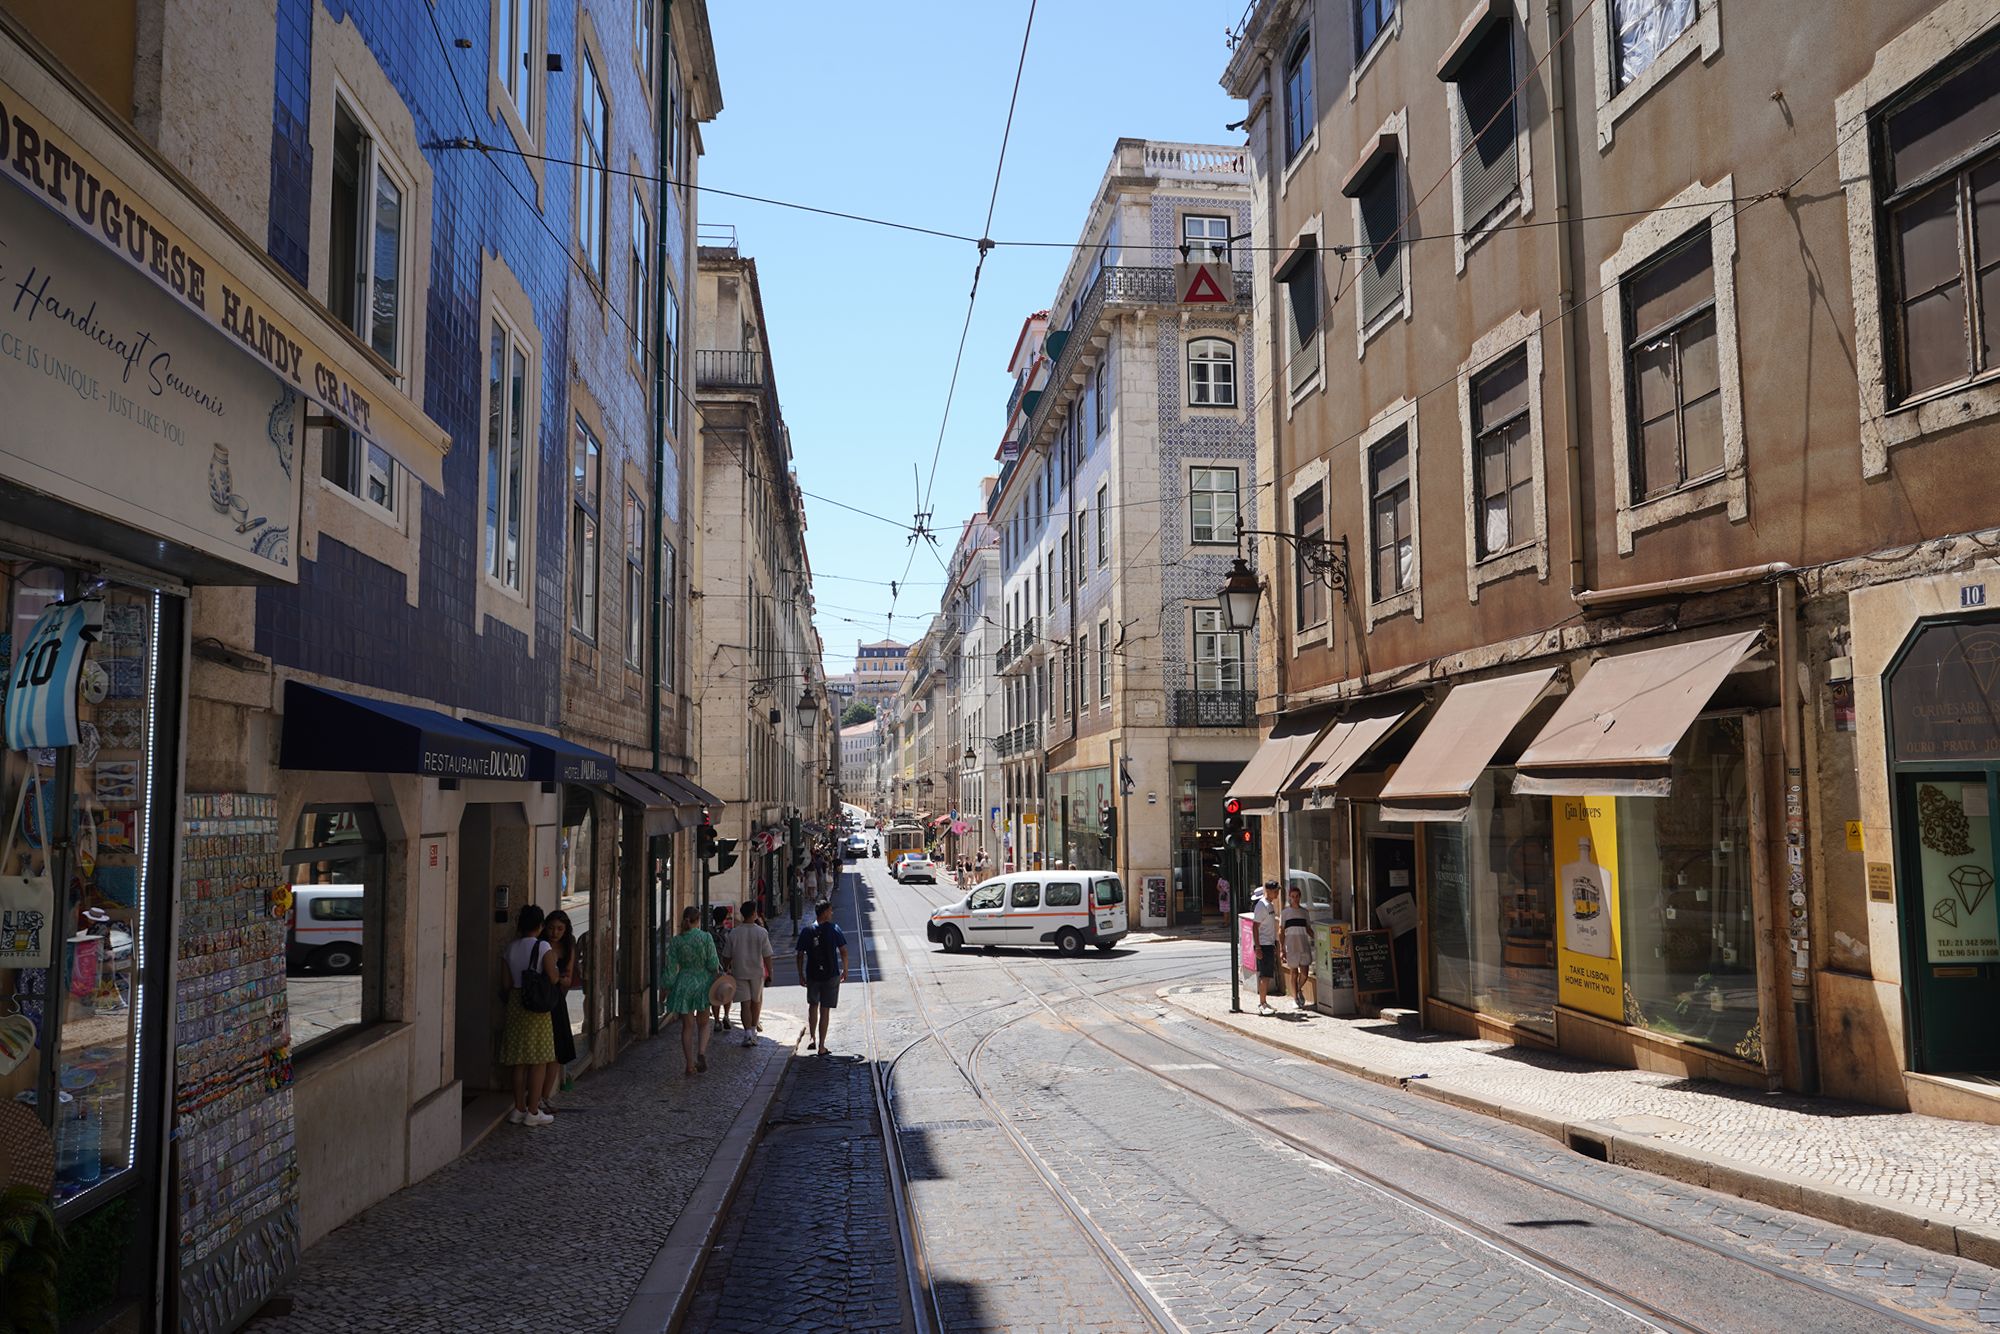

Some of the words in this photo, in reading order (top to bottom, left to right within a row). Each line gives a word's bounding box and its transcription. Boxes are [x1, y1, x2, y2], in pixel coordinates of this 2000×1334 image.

[14, 267, 157, 383] Handicraft
[148, 353, 224, 416] Souvenir
[221, 283, 303, 384] HANDY
[315, 362, 372, 435] CRAFT
[27, 345, 39, 369] IS
[44, 353, 98, 400] UNIQUE
[108, 390, 135, 413] JUST
[137, 405, 160, 434] LIKE
[162, 421, 185, 447] YOU
[1966, 586, 1980, 605] 10
[17, 638, 62, 688] 10
[1906, 741, 1935, 753] OURO
[1943, 739, 1977, 753] PRATA
[424, 752, 489, 776] RESTAURANTE
[490, 750, 526, 778] DUCADO
[1565, 802, 1578, 821] Gin
[1579, 802, 1602, 821] Lovers
[1955, 939, 1963, 947] 21
[1570, 965, 1585, 977] TAKE
[1586, 969, 1609, 982] LISBON
[1565, 975, 1582, 987] HOME
[1584, 980, 1600, 992] WITH
[1600, 984, 1616, 995] YOU
